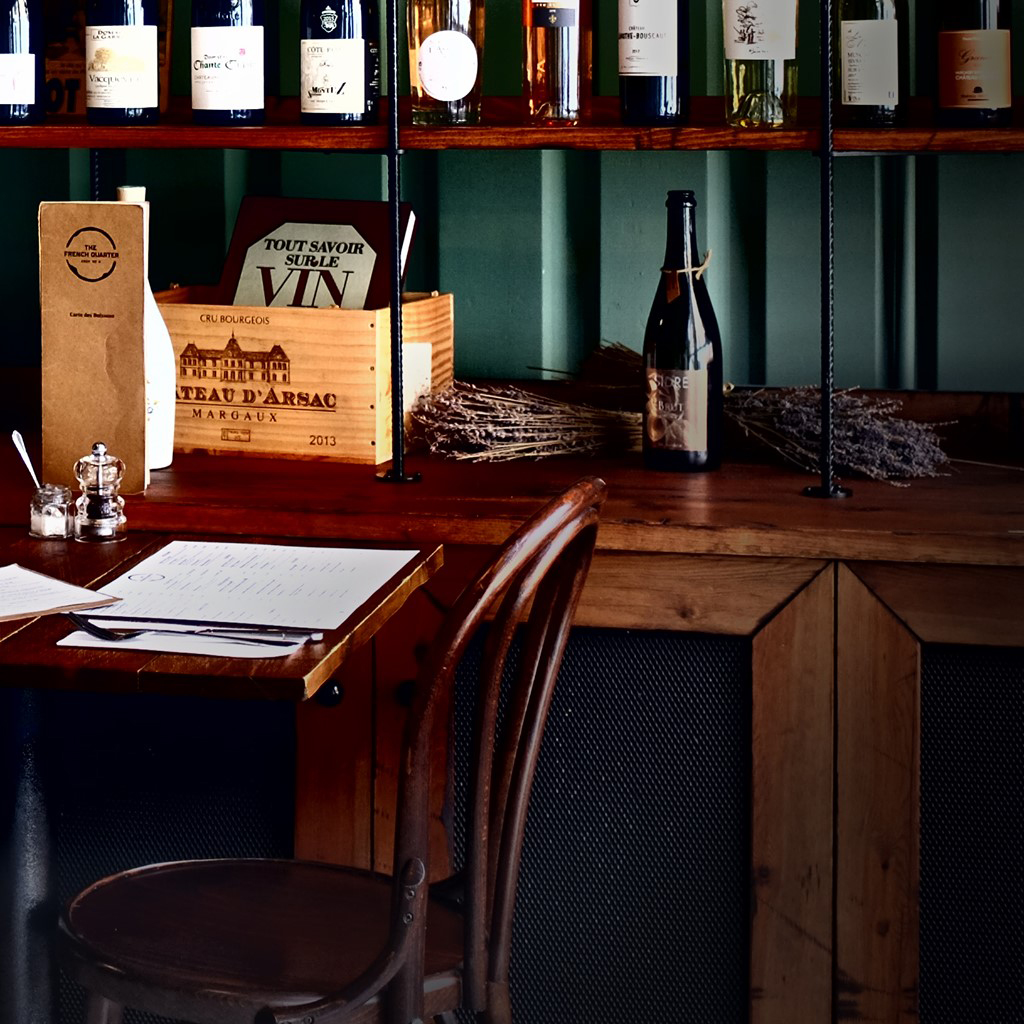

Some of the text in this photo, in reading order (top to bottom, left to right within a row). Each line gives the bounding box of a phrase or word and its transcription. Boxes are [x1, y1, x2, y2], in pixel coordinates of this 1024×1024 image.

[264, 237, 365, 256] TOUT SAVOIR
[284, 254, 340, 268] SUR LE
[256, 266, 354, 308] VIN
[200, 314, 270, 326] CRU BOURGEOIS
[242, 387, 338, 409] D'ARSAC
[192, 408, 278, 423] MARGAUX
[309, 435, 337, 447] 2013
